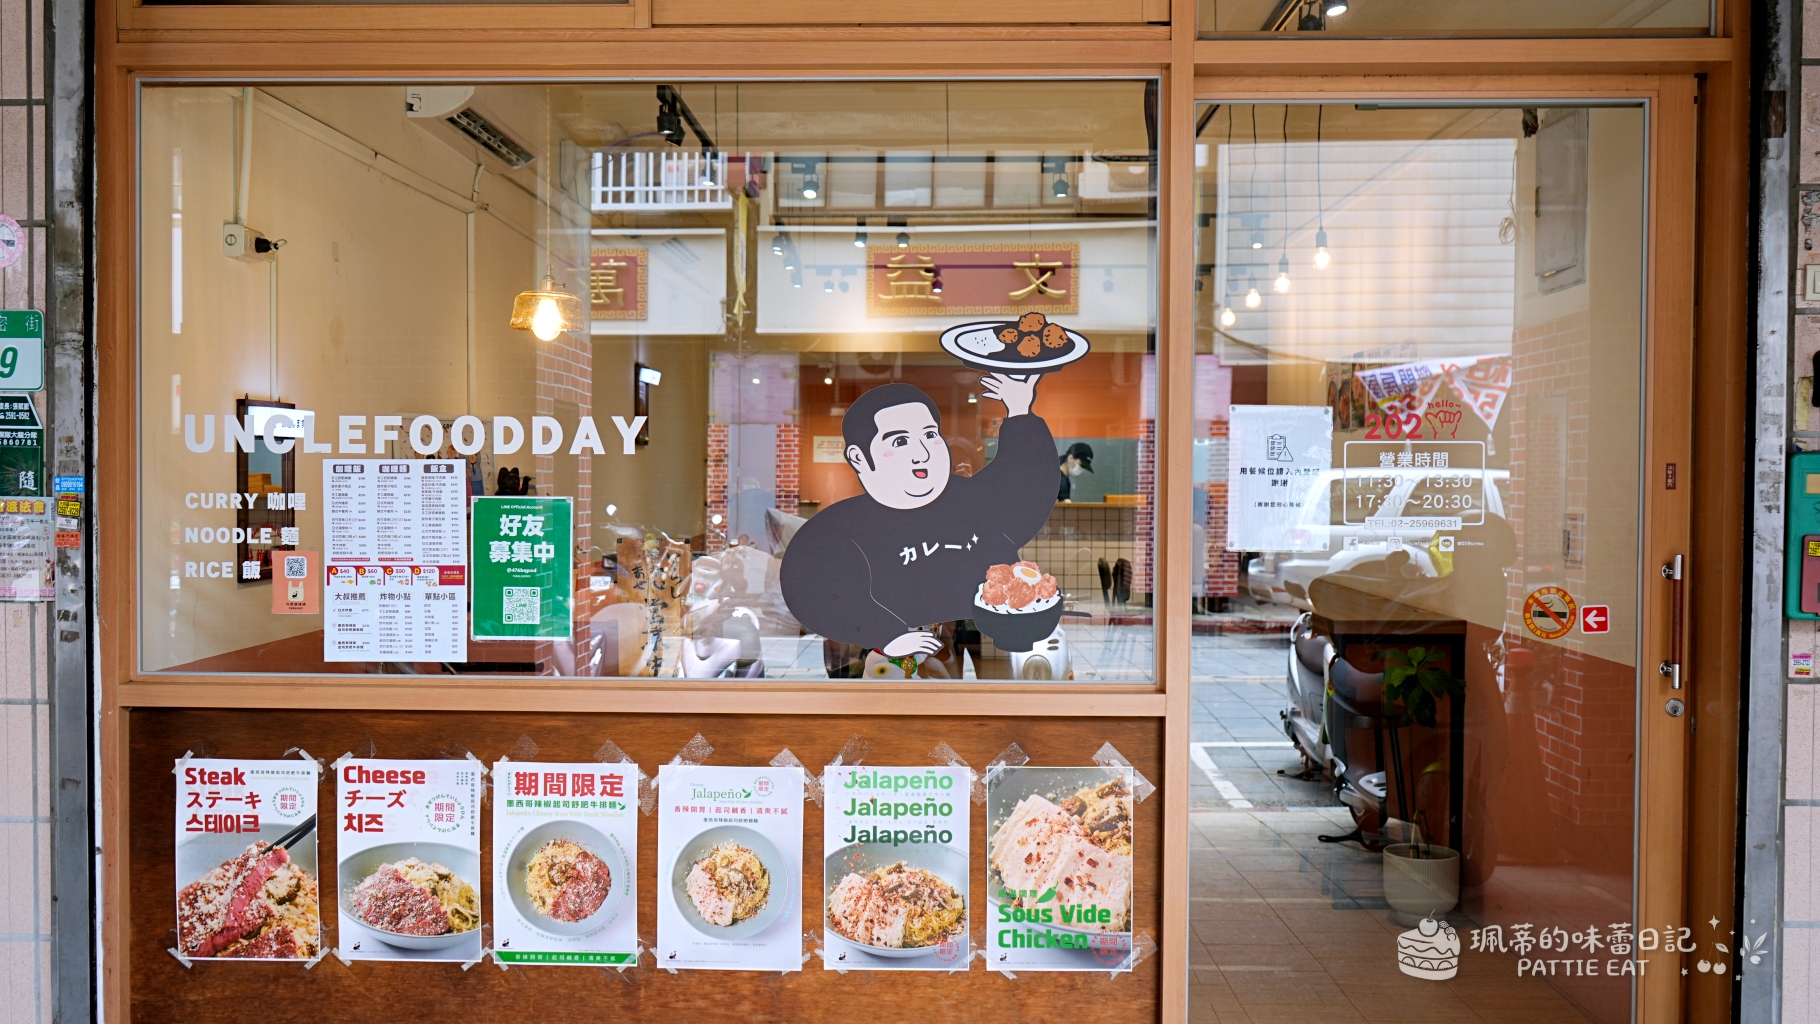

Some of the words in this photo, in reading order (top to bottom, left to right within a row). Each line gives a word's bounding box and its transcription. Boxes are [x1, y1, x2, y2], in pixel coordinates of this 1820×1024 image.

[185, 414, 648, 454] UNCLEFOODDAY
[1379, 452, 1449, 468] 營業時間
[19, 470, 37, 490] 隨
[1271, 479, 1288, 487] 謝謝
[185, 492, 259, 510] CURRY
[267, 492, 306, 510] 咖哩
[499, 513, 545, 537] 好友
[185, 527, 272, 544] NOODLE
[489, 540, 555, 563] 募集中
[899, 542, 963, 565] カレー
[185, 562, 233, 578] RICE
[242, 560, 261, 579] 飯
[380, 592, 411, 601] 炸物小點
[185, 767, 246, 785] Steak
[344, 765, 426, 784] Cheese
[843, 770, 953, 792] Jalapeño
[515, 772, 624, 798] 期間限定
[691, 787, 742, 801] Jalapeño
[187, 791, 262, 809] ステーキ
[280, 794, 297, 802] 期間
[344, 789, 407, 808] チーズ
[434, 802, 455, 812] 期間
[506, 800, 617, 809] 墨西哥辣椒起司舒肥牛排麵
[434, 813, 455, 822] 限定
[533, 810, 553, 818] Cheesy
[674, 805, 706, 813] 香辣開胃
[843, 797, 953, 820] Jalapeño
[185, 814, 260, 834] 스테이크
[343, 813, 384, 833] 치즈
[843, 824, 953, 847] Jalapeño
[998, 903, 1053, 923] Sous
[1059, 904, 1111, 923] Vide
[998, 928, 1088, 949] Chicken
[1100, 937, 1118, 946] 期間
